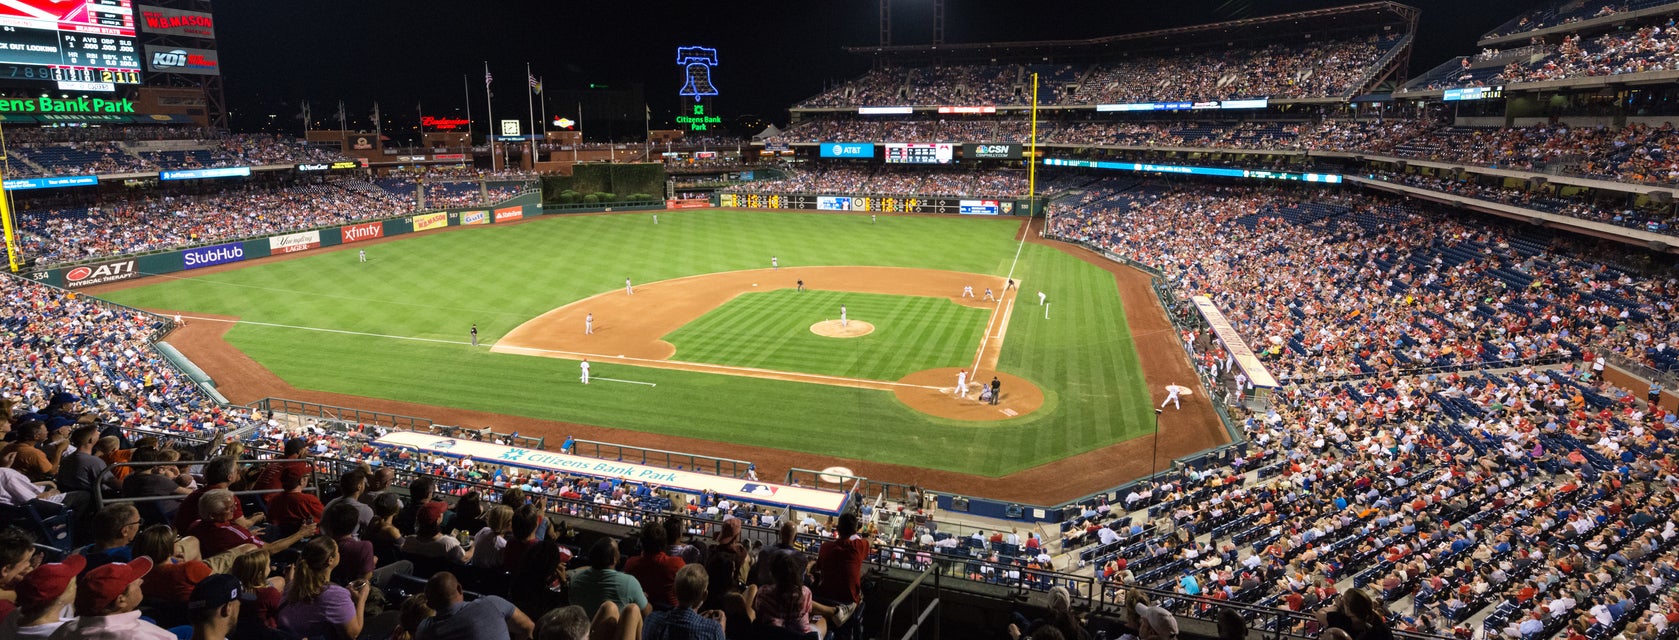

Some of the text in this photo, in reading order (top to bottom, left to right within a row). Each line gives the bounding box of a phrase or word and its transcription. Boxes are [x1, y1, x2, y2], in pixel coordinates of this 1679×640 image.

[9, 66, 18, 78] 7
[24, 67, 34, 78] 8
[39, 68, 48, 78] 9
[102, 72, 138, 84] 2 1 1
[39, 97, 91, 112] Bank
[93, 98, 135, 113] Park
[692, 122, 706, 130] Park
[988, 145, 1010, 154] CSN
[465, 212, 484, 222] Gulf
[345, 224, 380, 240] xfinity
[286, 244, 308, 252] LAGER
[185, 246, 243, 266] StubHub
[90, 260, 134, 278] ATI
[33, 272, 49, 280] 334
[68, 272, 132, 288] PHYSICAL THERAPY
[528, 453, 678, 482] Citizens Bank Park
